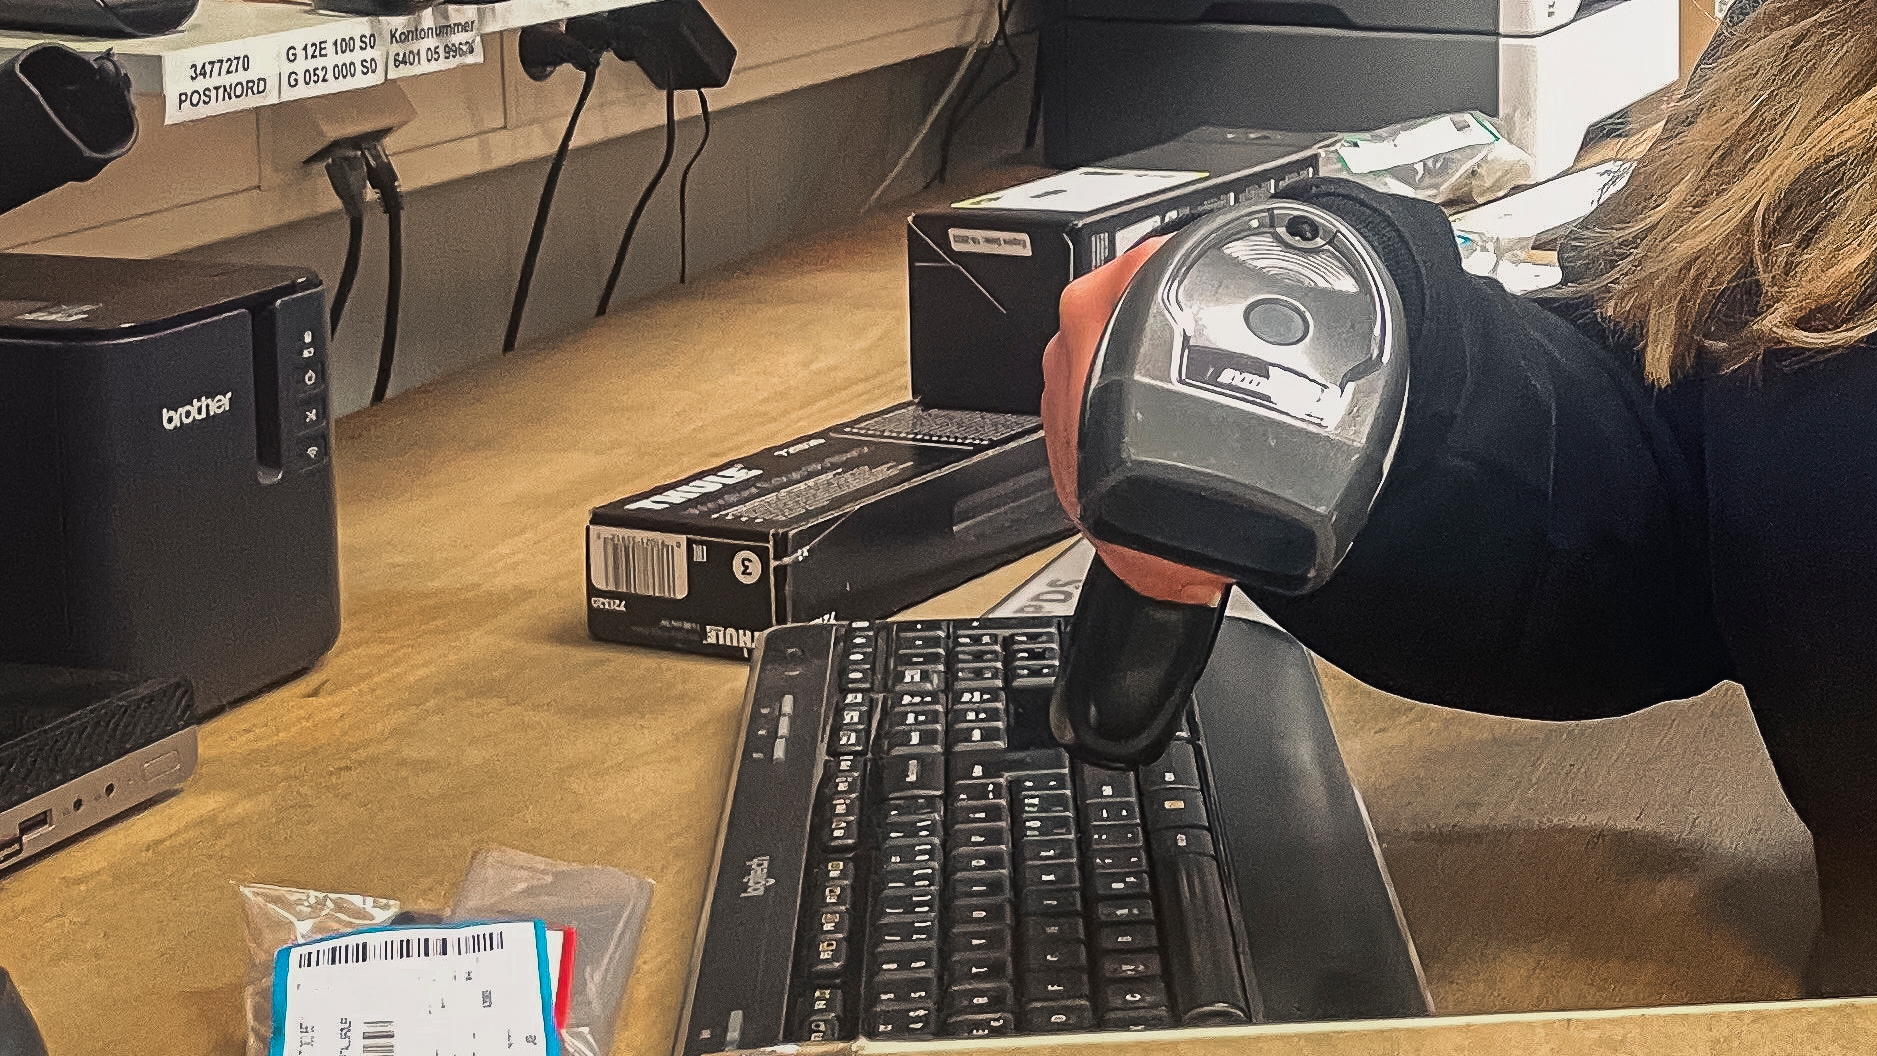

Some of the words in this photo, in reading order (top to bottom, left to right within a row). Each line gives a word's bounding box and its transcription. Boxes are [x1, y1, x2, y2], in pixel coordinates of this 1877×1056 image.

[389, 19, 476, 45] Kontonummer
[286, 45, 298, 63] G
[302, 39, 328, 61] 12E
[332, 36, 356, 56] 100
[393, 48, 421, 69] 6401
[425, 45, 441, 62] 05
[190, 54, 250, 81] 3477270
[287, 70, 299, 89] G
[303, 65, 329, 86] 052
[332, 61, 357, 81] 000
[179, 77, 267, 111] POSTNORD
[162, 391, 232, 431] brother
